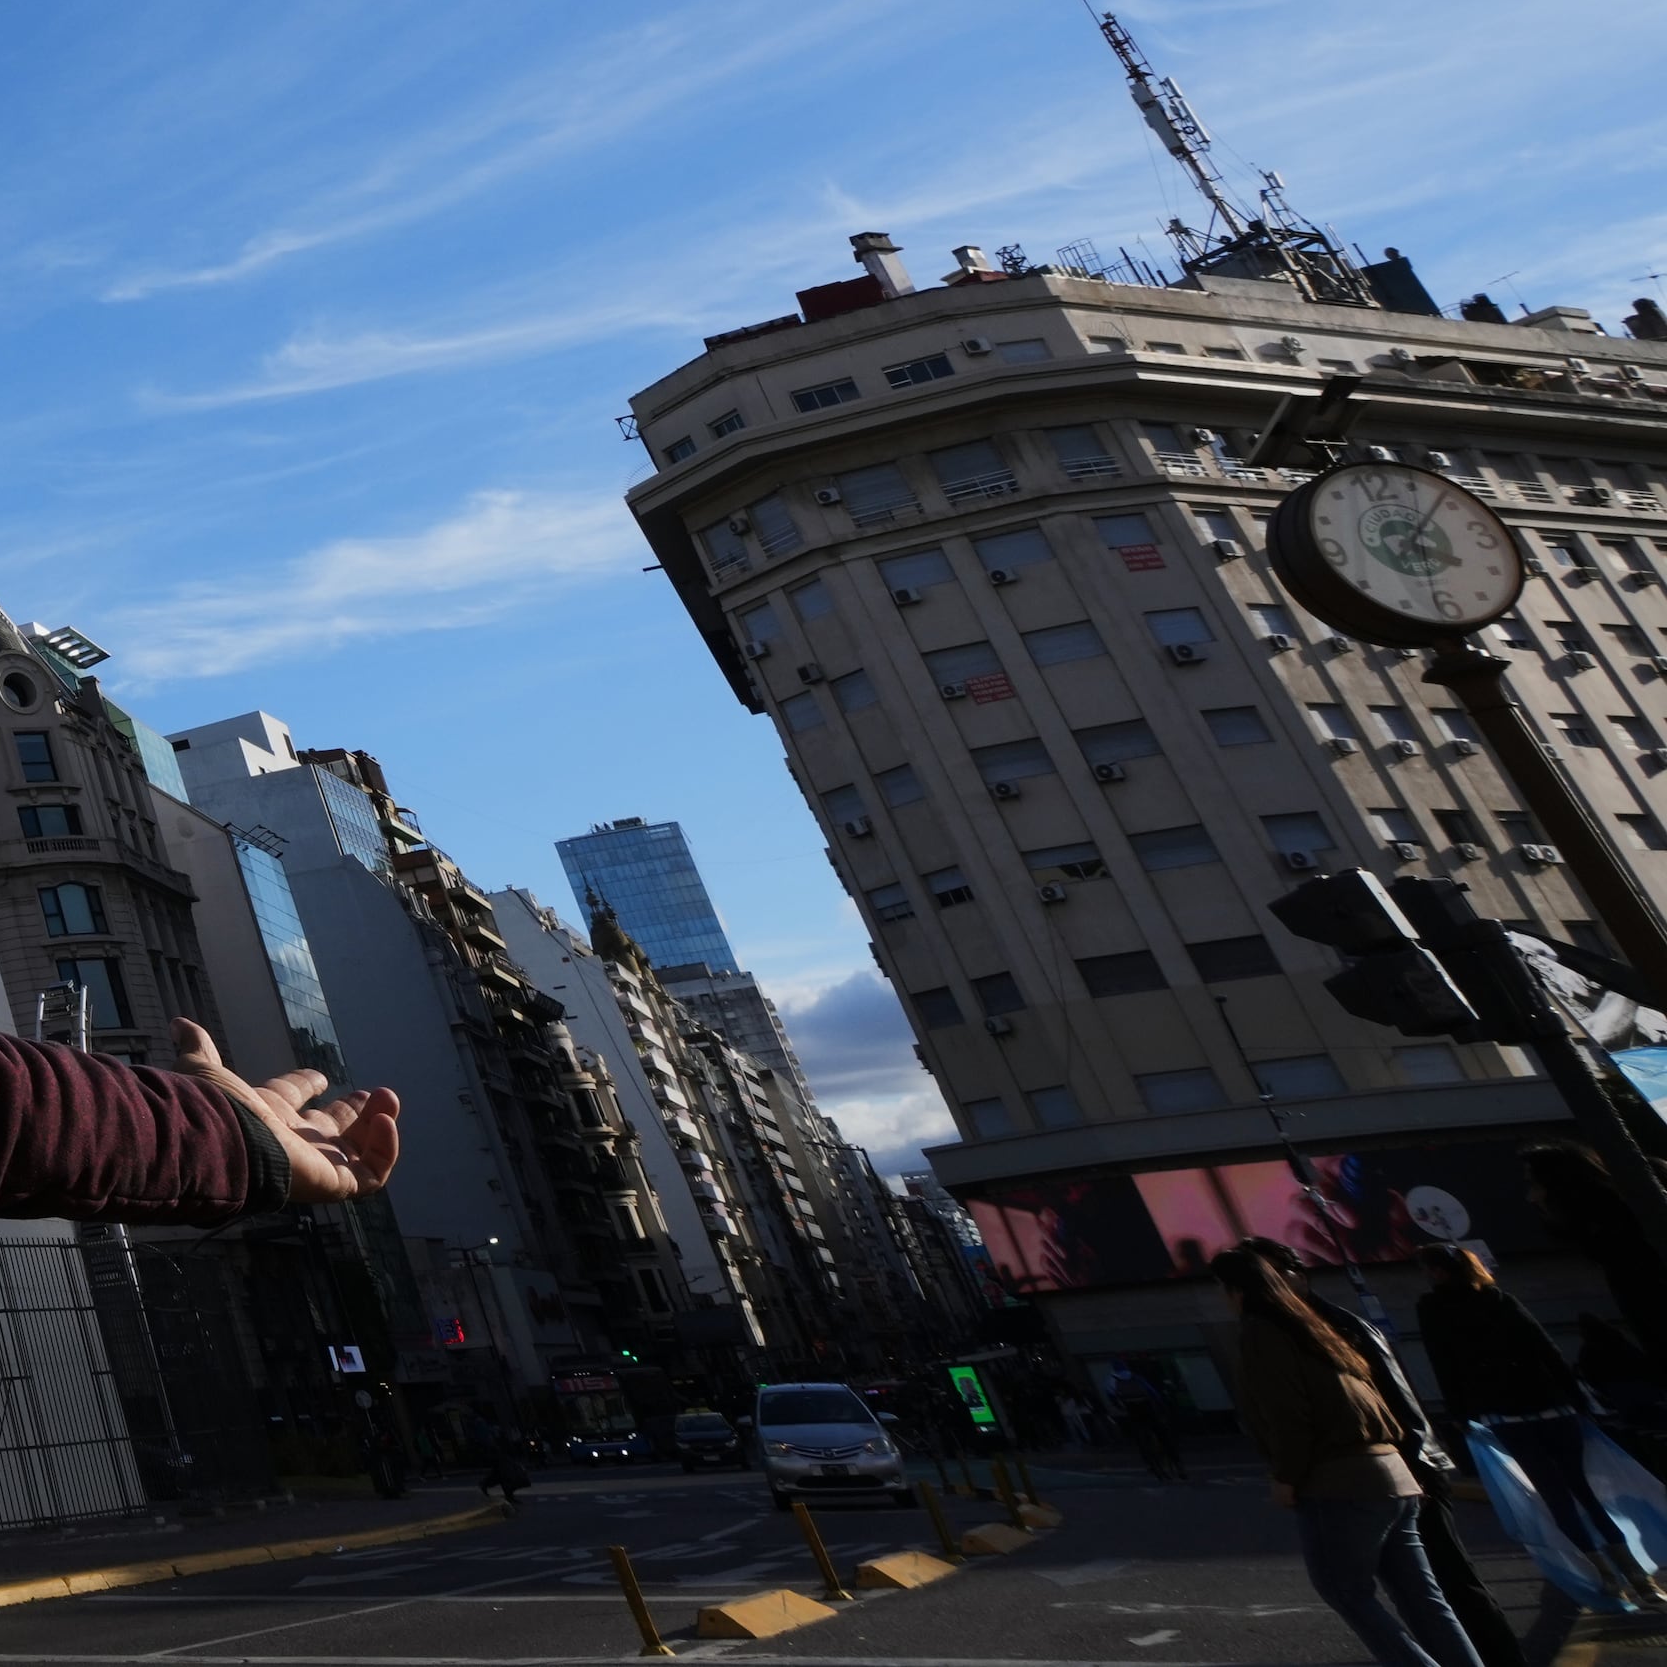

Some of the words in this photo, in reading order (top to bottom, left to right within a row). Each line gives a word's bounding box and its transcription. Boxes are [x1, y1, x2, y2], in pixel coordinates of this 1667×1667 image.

[1351, 472, 1399, 502] 12
[1368, 507, 1416, 534] CIUDAD
[1467, 520, 1499, 550] 3
[1320, 537, 1348, 566] 9
[1432, 590, 1464, 619] 6
